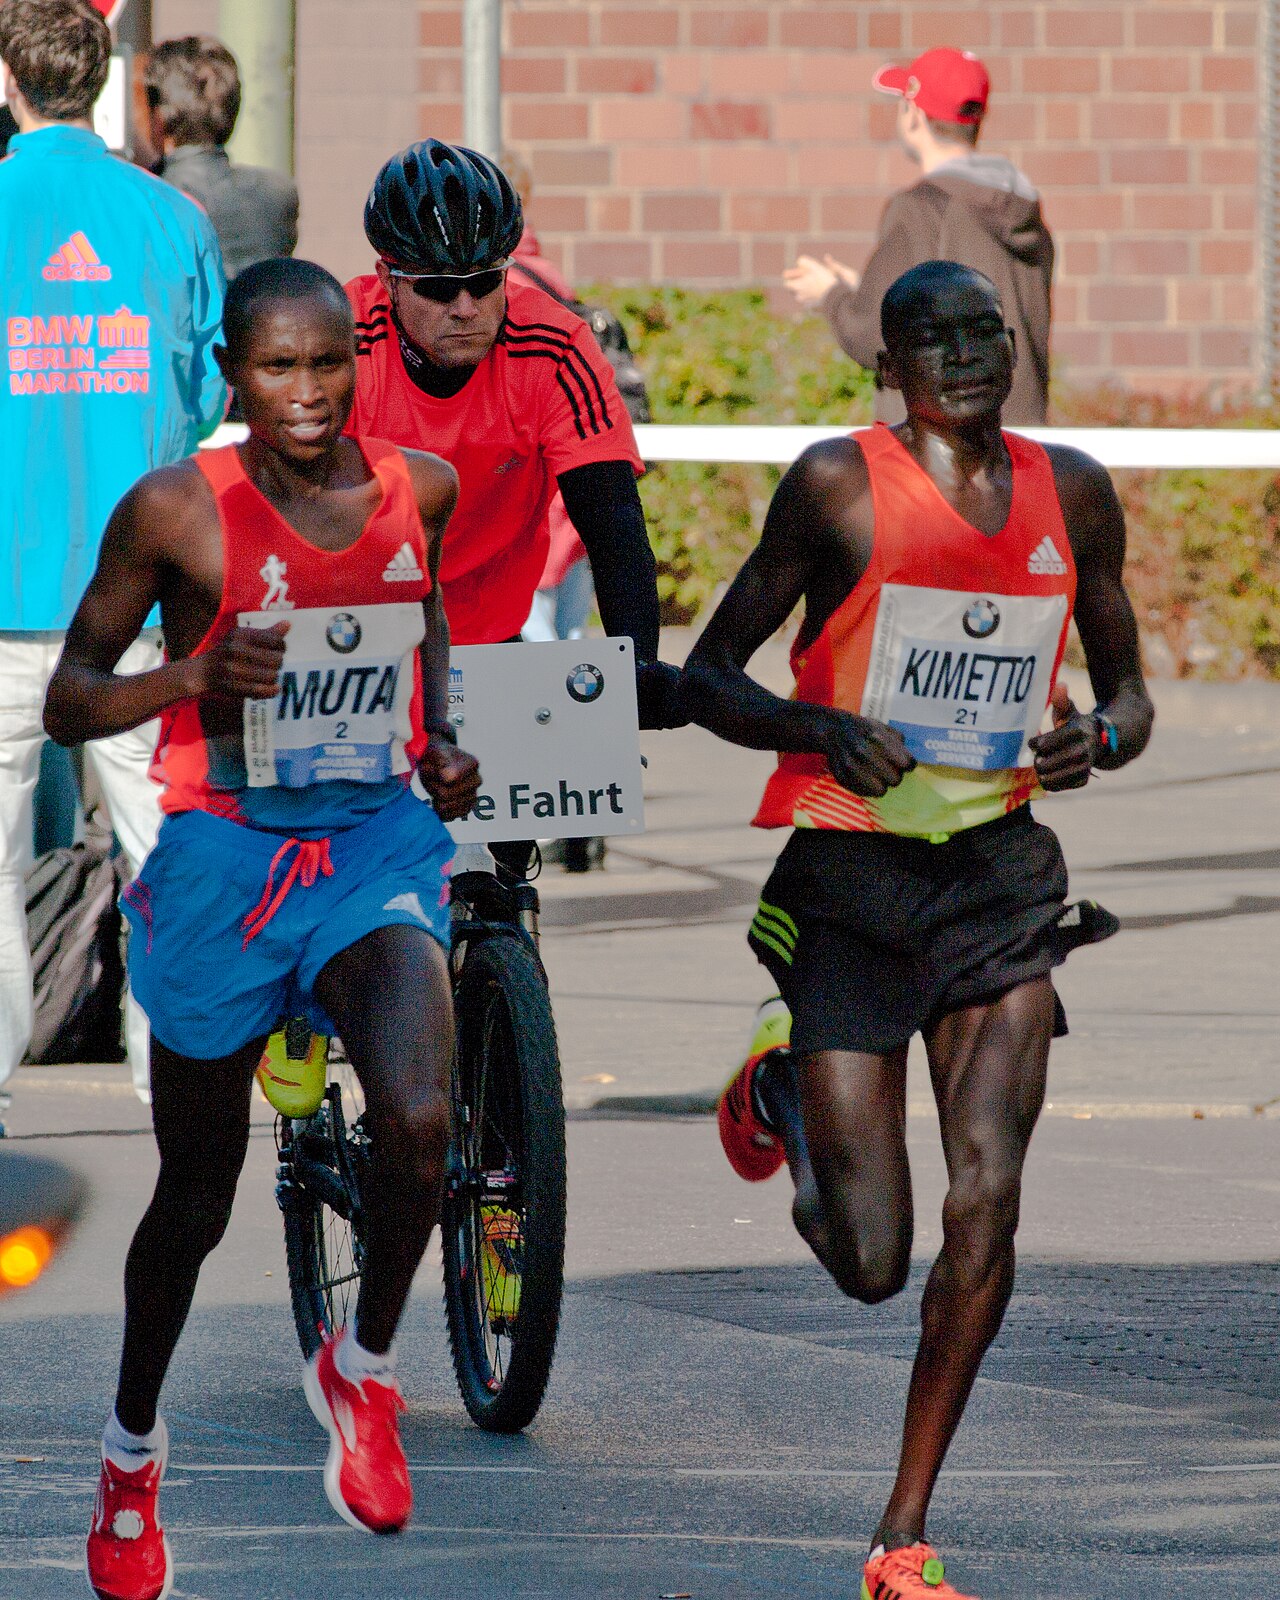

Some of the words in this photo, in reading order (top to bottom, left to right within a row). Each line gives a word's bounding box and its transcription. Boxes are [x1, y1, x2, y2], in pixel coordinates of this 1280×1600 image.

[42, 264, 112, 281] adidas
[8, 315, 94, 346] BMW
[9, 347, 94, 371] BERLIN
[10, 371, 149, 395] MARATHON
[899, 647, 1036, 704] KIMETTO
[954, 708, 978, 725] 21
[335, 721, 349, 739] 2
[509, 780, 624, 820] Fahrt
